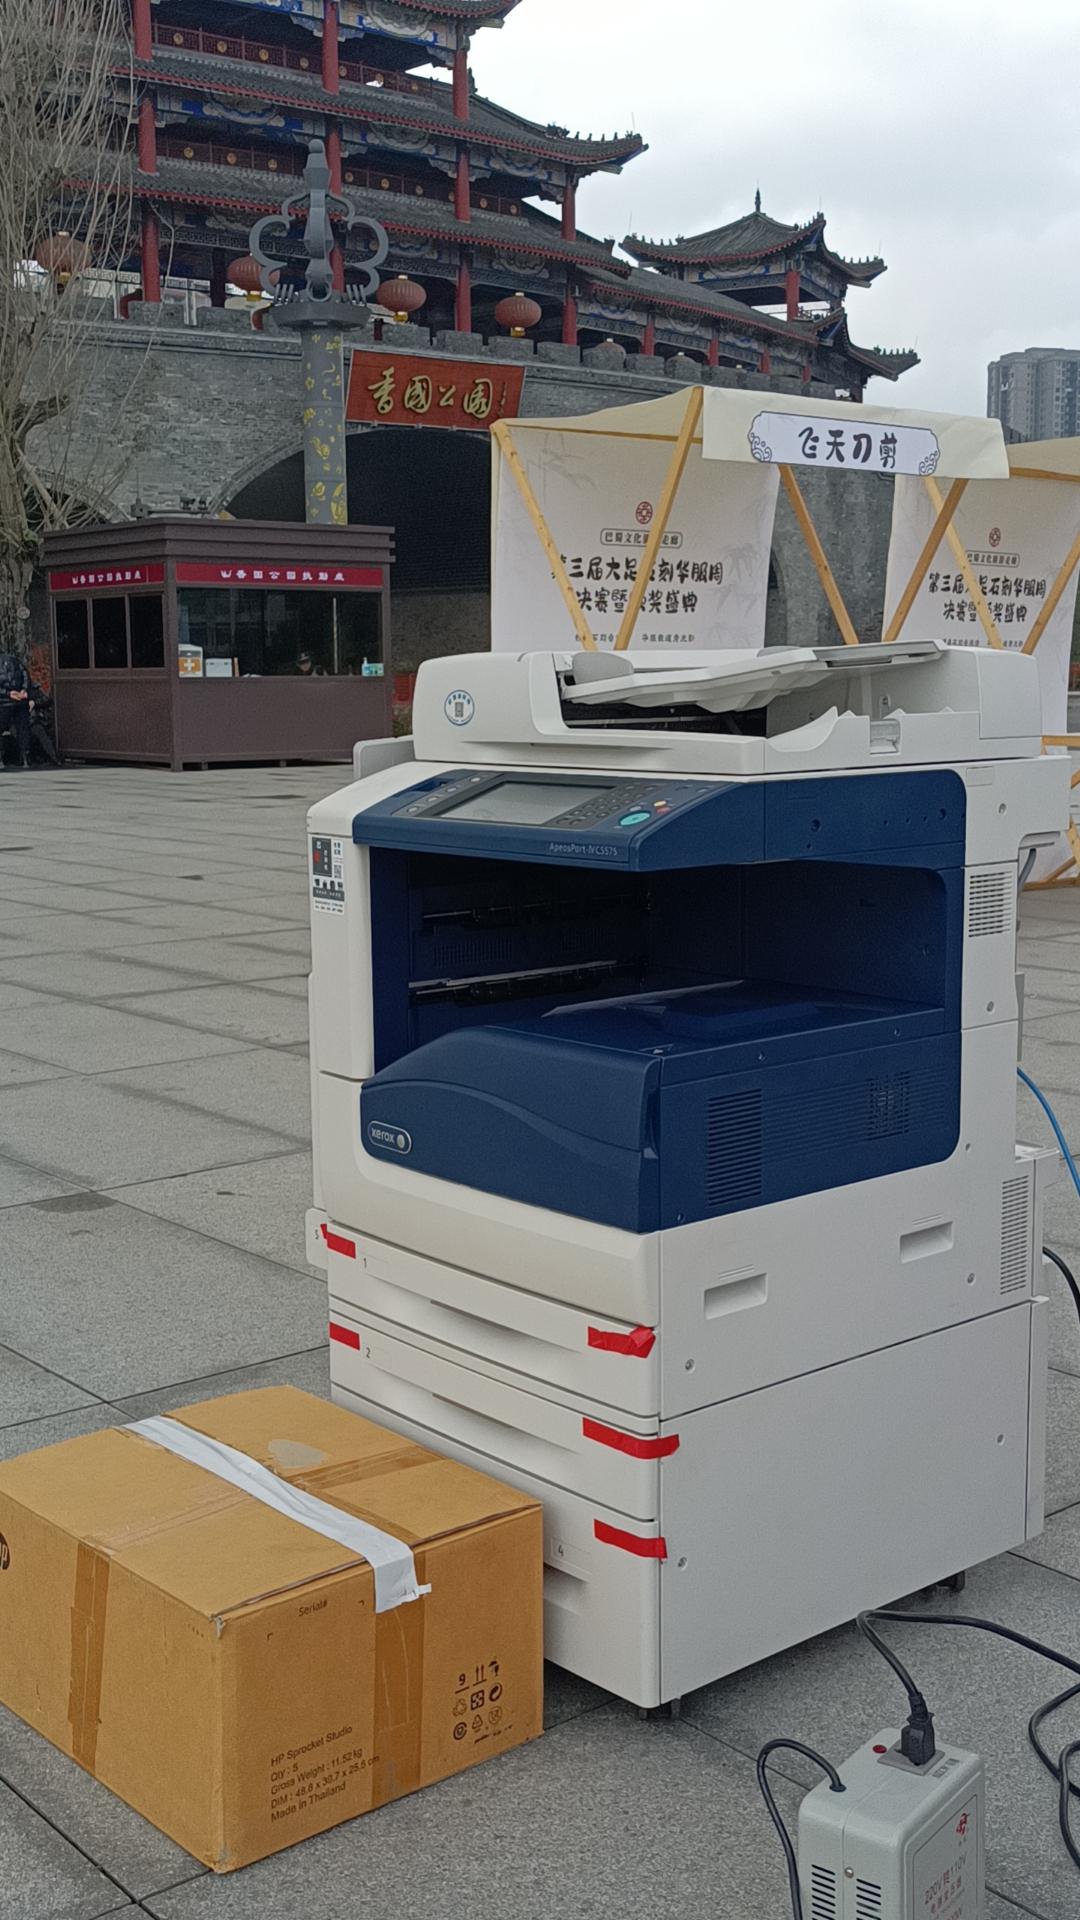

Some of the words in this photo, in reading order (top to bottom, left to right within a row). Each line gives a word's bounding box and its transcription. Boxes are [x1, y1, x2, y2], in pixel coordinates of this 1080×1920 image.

[798, 426, 898, 469] 飞天刀剪
[551, 554, 723, 584] 三届大足刻华服周
[928, 572, 1046, 599] 第三届足石刻华服周
[371, 1127, 395, 1144] xerox
[271, 1753, 284, 1767] HP
[286, 1737, 324, 1760] Sprocket
[326, 1726, 353, 1743] Studio
[271, 1778, 295, 1795] Gross
[353, 1748, 363, 1759] kg
[292, 1762, 299, 1773] 5
[271, 1805, 297, 1822] Made
[299, 1800, 307, 1811] in
[308, 1781, 346, 1805] Thailand
